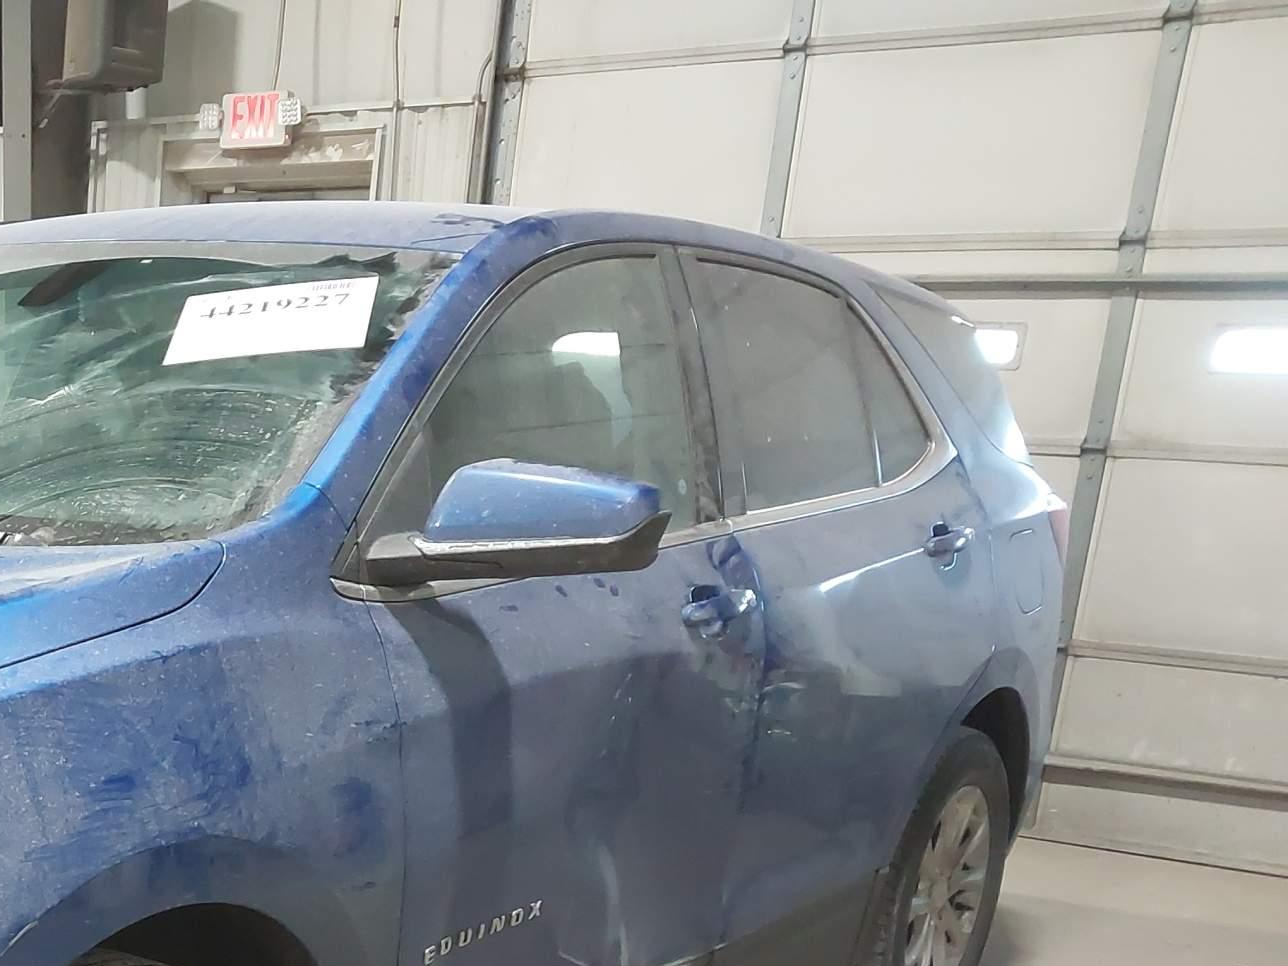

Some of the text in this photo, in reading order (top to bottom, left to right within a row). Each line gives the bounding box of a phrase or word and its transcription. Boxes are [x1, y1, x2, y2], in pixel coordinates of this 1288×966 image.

[231, 92, 280, 139] EXIT
[199, 292, 350, 319] 44219227
[423, 900, 543, 966] EQUINOX
